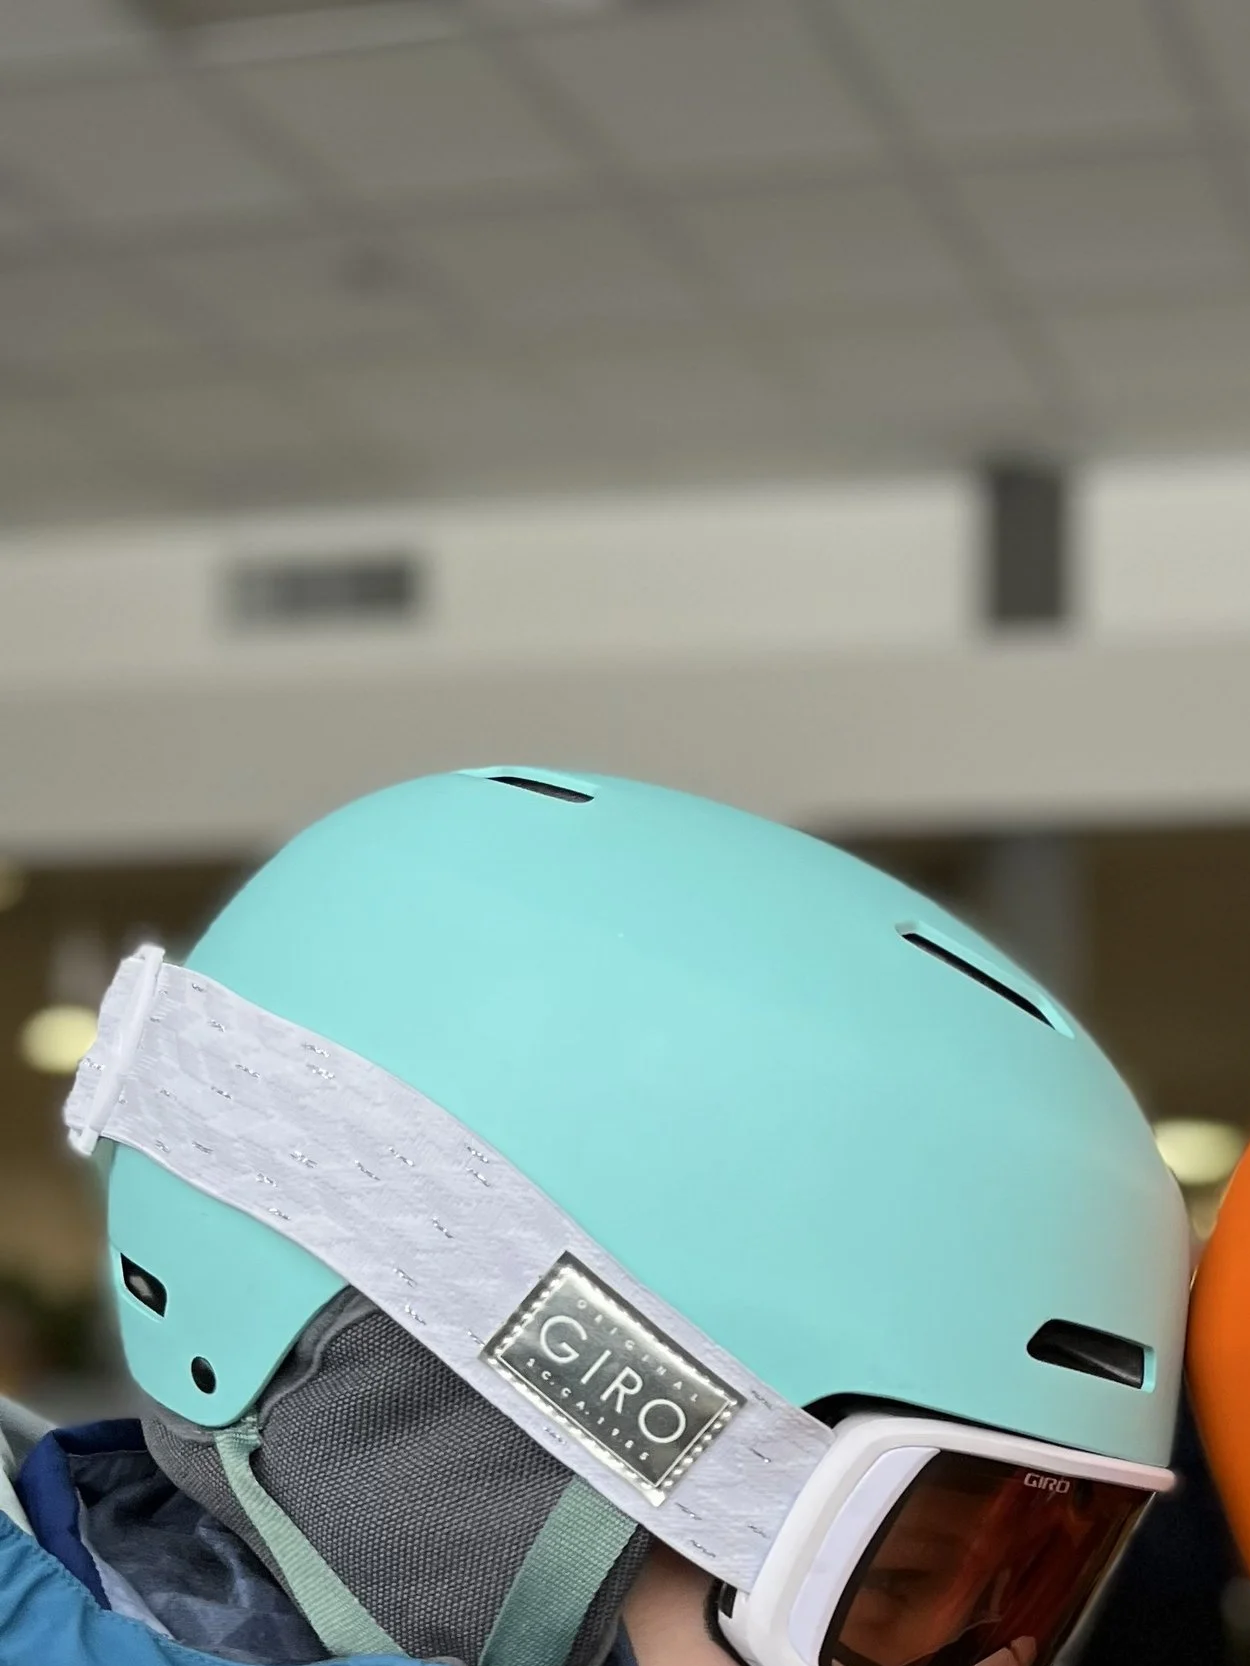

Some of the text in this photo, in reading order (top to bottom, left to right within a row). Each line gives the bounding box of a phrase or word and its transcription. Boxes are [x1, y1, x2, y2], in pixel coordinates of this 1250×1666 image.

[539, 1315, 687, 1444] GIRO
[577, 1299, 699, 1403] ORIGINAL
[1023, 1472, 1071, 1494] GIRO
